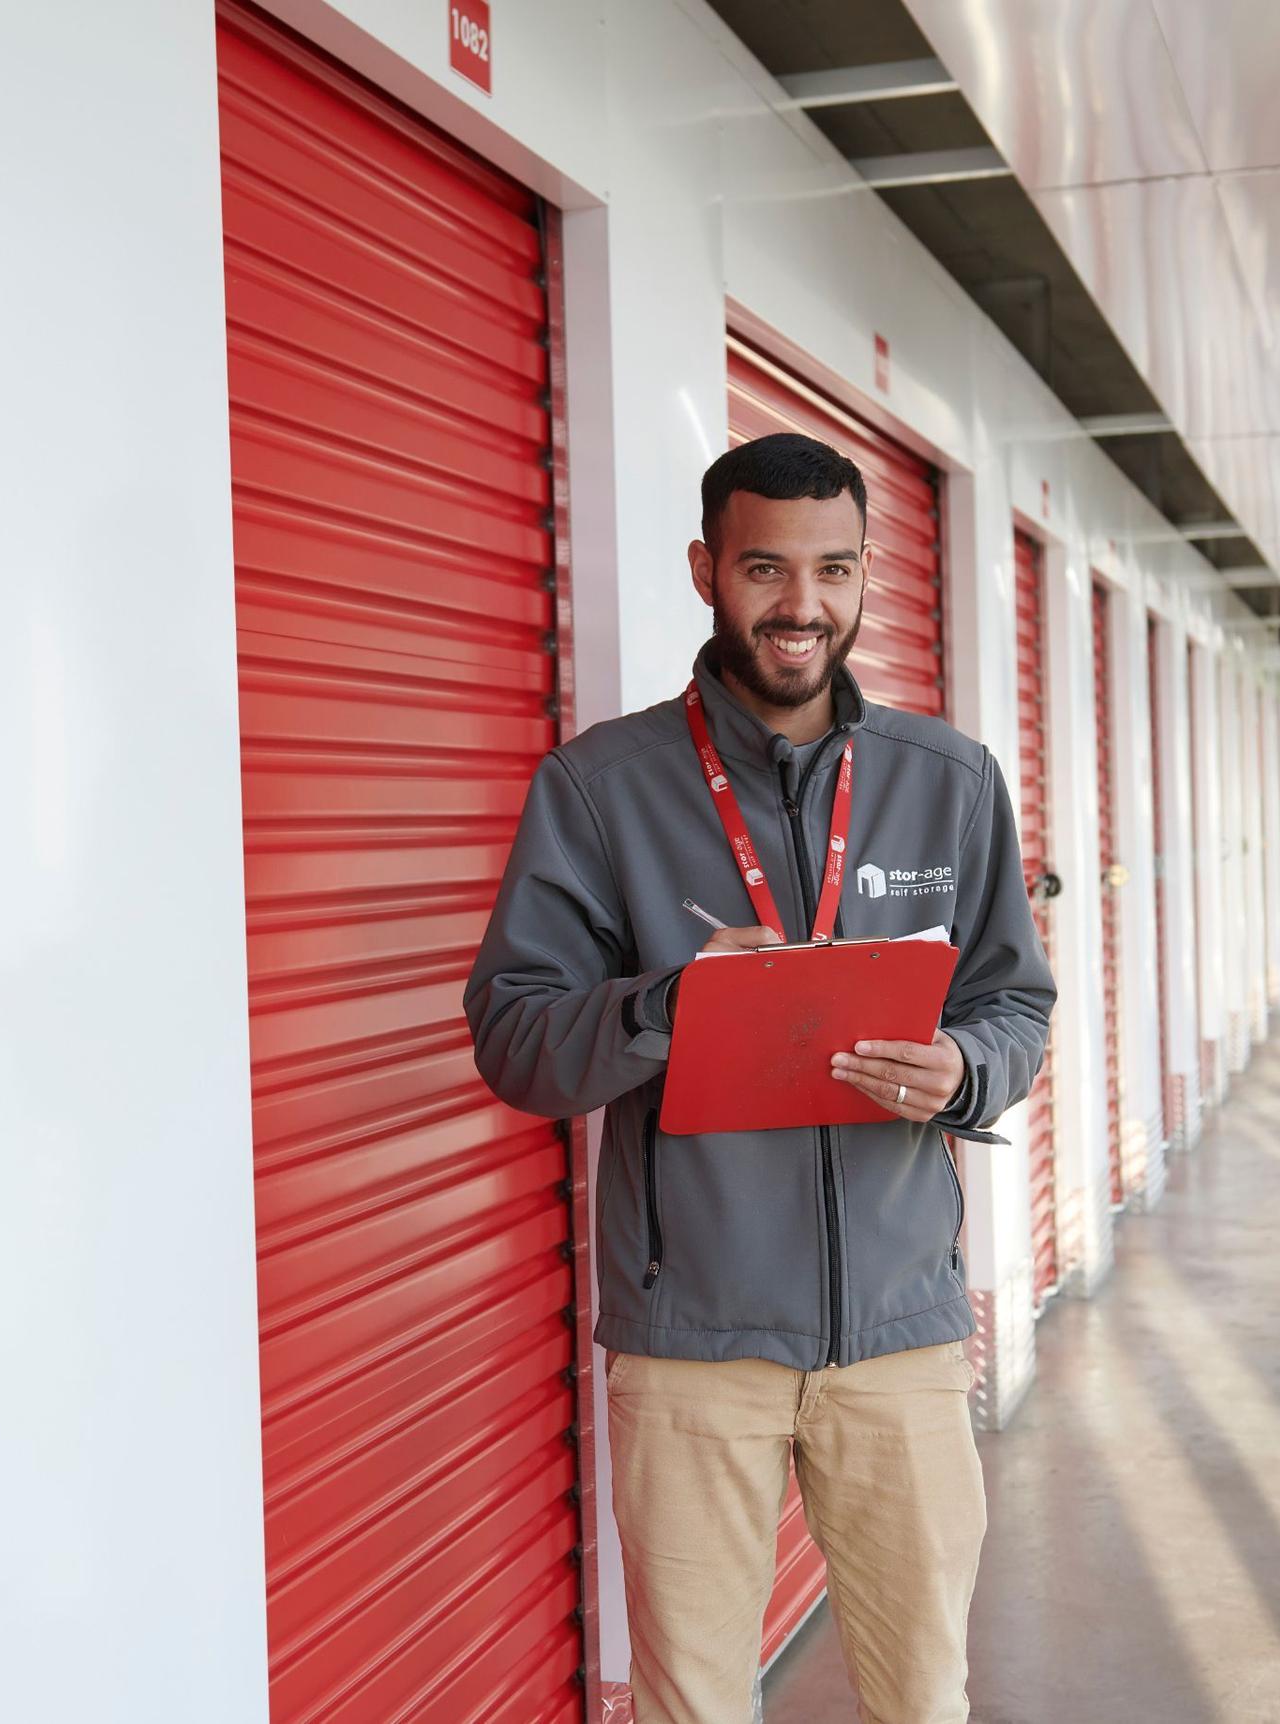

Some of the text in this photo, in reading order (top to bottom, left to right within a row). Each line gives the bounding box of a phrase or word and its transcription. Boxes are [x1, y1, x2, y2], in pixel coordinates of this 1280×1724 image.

[452, 8, 488, 61] 1082
[889, 866, 952, 881] stor-age
[890, 884, 954, 897] self storage
